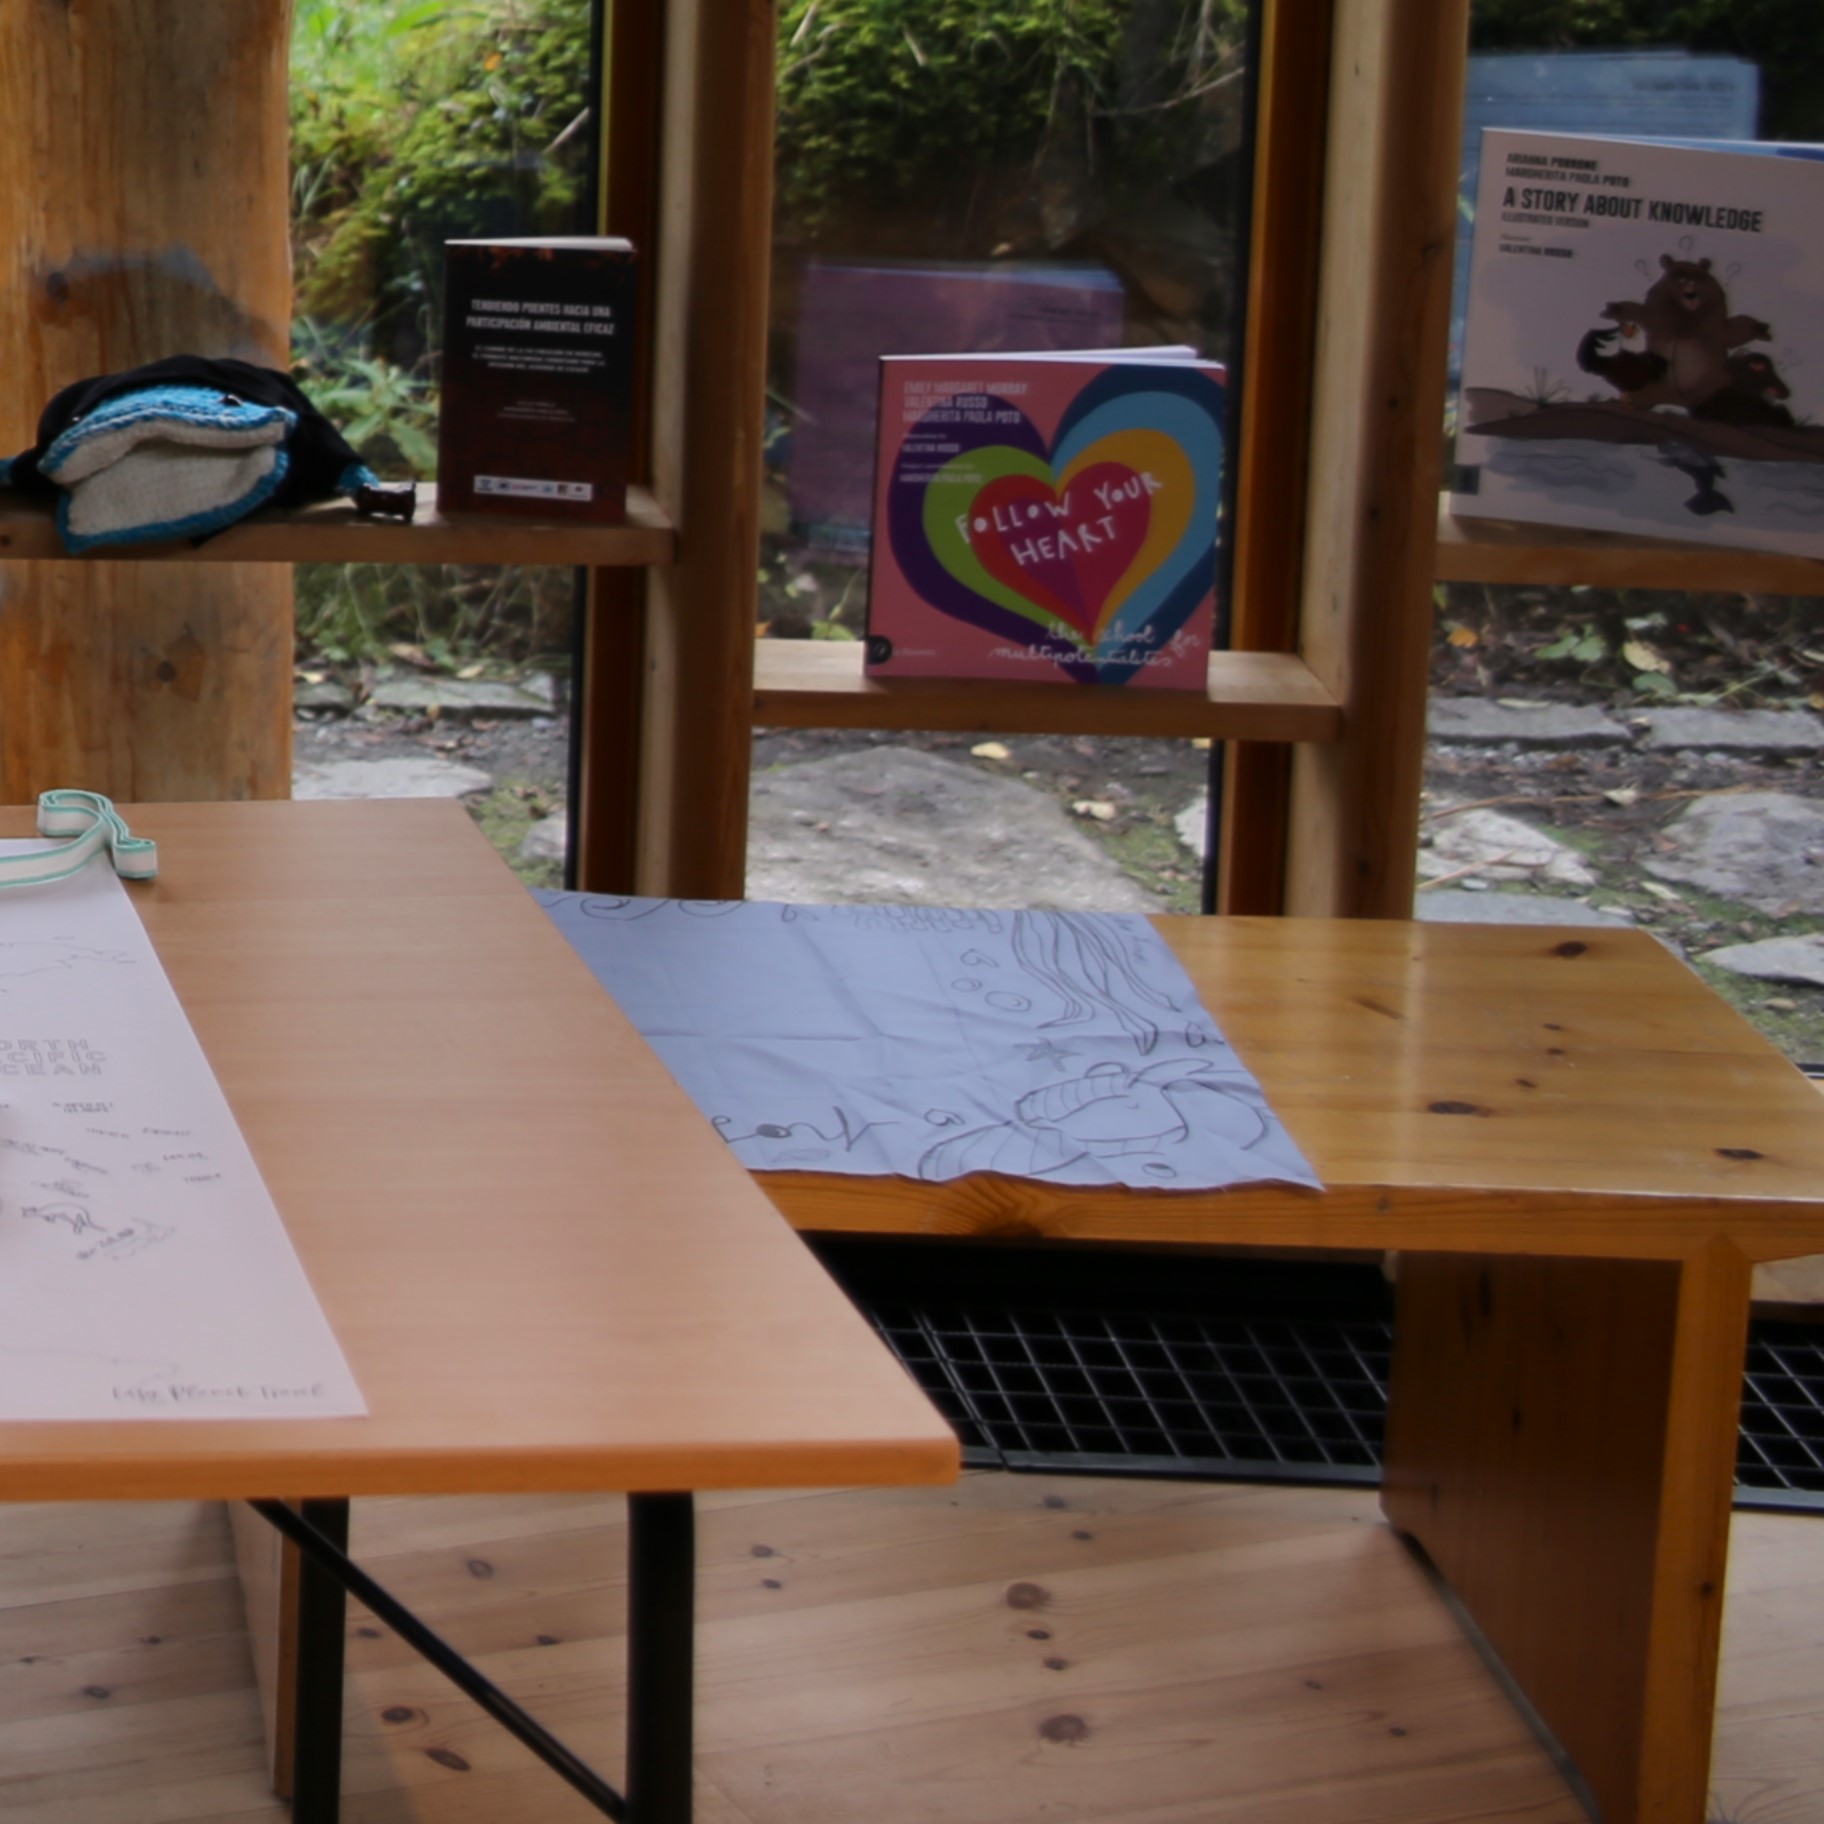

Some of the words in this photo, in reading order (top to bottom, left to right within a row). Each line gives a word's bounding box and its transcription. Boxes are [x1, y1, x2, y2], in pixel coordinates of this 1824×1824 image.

[1507, 153, 1547, 166] ARIANNA
[1550, 157, 1598, 170] PORRONE
[1505, 167, 1566, 182] MARGHERITA
[1568, 172, 1601, 185] PAOLA
[1602, 175, 1629, 188] POTO
[1503, 187, 1515, 207] A
[1521, 188, 1580, 212] STORY
[1583, 195, 1643, 219] ABOUT
[1648, 201, 1763, 233] KNOWLEDGE
[904, 380, 932, 394] EMILY
[933, 380, 985, 394] MARGARET
[986, 382, 1029, 395] MURRAY
[903, 395, 953, 409] VALENTINA
[956, 396, 989, 409] RUSSO
[902, 410, 961, 423] MARGHERITA
[962, 410, 993, 424] PAOLA
[995, 411, 1021, 425] POTO
[1009, 515, 1117, 566] HEART
[1045, 622, 1083, 641] the
[1168, 630, 1201, 658] for
